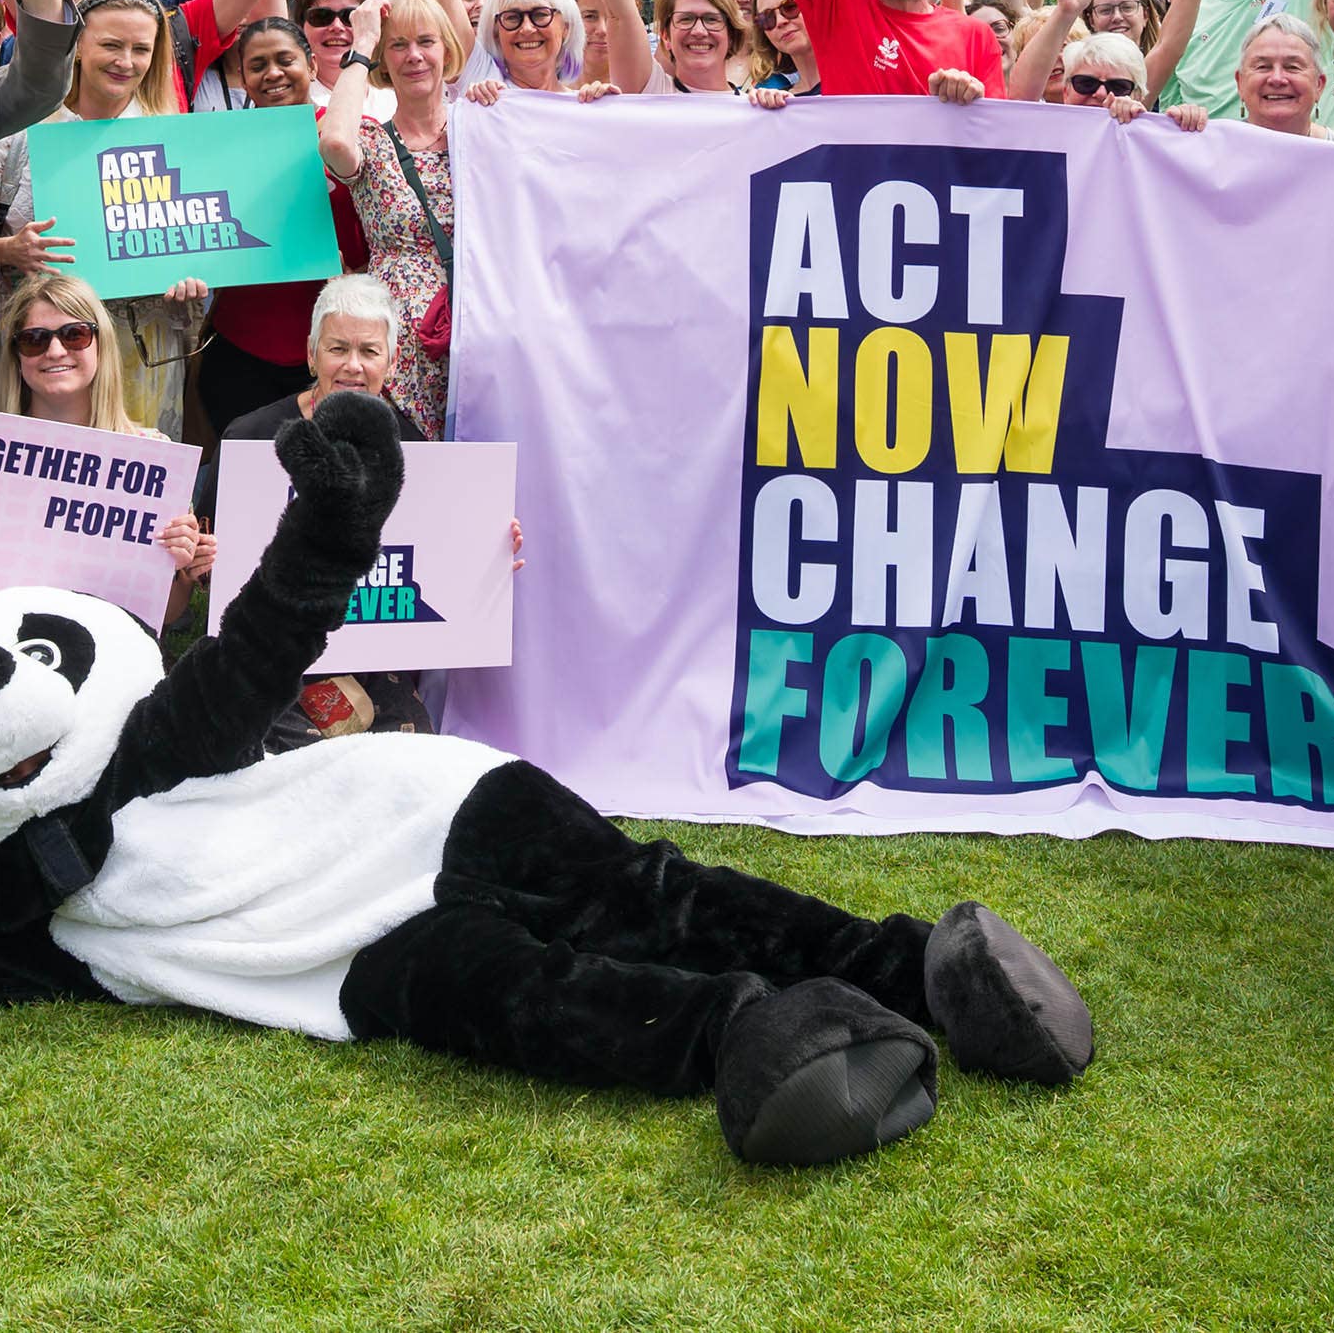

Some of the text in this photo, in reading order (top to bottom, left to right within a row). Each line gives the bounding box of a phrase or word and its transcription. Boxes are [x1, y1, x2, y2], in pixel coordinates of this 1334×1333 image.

[102, 151, 156, 179] ACT
[102, 175, 171, 206] NOW
[106, 197, 222, 232] CHANGE
[108, 222, 239, 258] FOREVER
[764, 180, 1025, 325] ACT
[756, 325, 1069, 475] NOW
[106, 457, 167, 498] FOR
[44, 496, 158, 546] PEOPLE
[751, 474, 1279, 654] CHANGE
